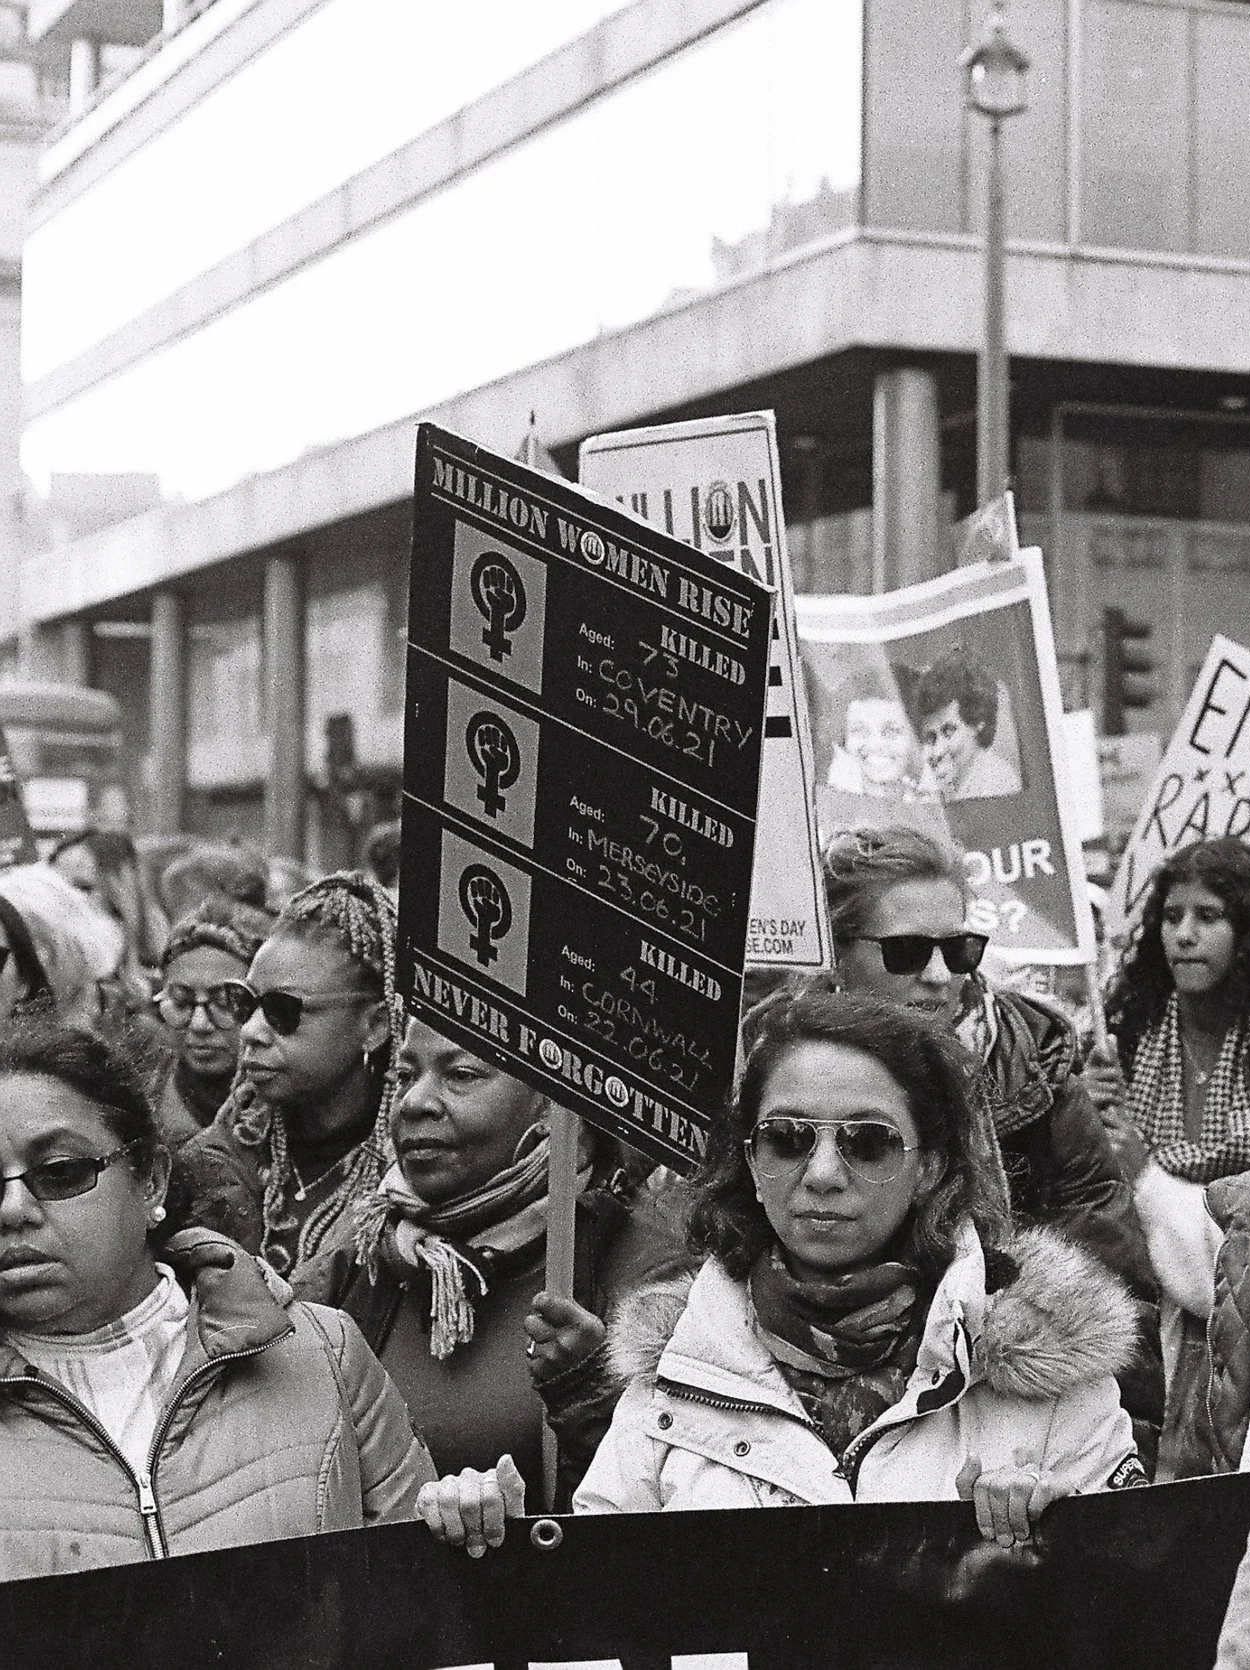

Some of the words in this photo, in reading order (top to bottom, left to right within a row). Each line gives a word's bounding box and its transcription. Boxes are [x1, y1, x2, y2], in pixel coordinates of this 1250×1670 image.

[432, 456, 549, 540] MILLION
[557, 517, 671, 599] WOMEN
[677, 575, 752, 639] RISE
[579, 622, 615, 650] Aged:
[638, 640, 680, 678] 73
[660, 624, 746, 686] KILLED
[575, 687, 597, 708] On:
[602, 692, 716, 768] 29.06.21
[577, 654, 592, 674] In:
[598, 658, 753, 751] COVENTRY
[567, 826, 583, 845] In:
[569, 794, 605, 823] Aged:
[650, 785, 735, 848] KILLED
[565, 857, 587, 878] On:
[597, 864, 706, 942] 23.06.21
[779, 918, 807, 937] DAY
[561, 944, 596, 972] Aged:
[639, 939, 722, 1001] KILLED
[412, 961, 511, 1044] NEVER
[556, 1003, 578, 1024] On:
[559, 974, 575, 993] In:
[582, 982, 713, 1070] CORNWALL
[518, 1023, 712, 1159] FORGOTTEN
